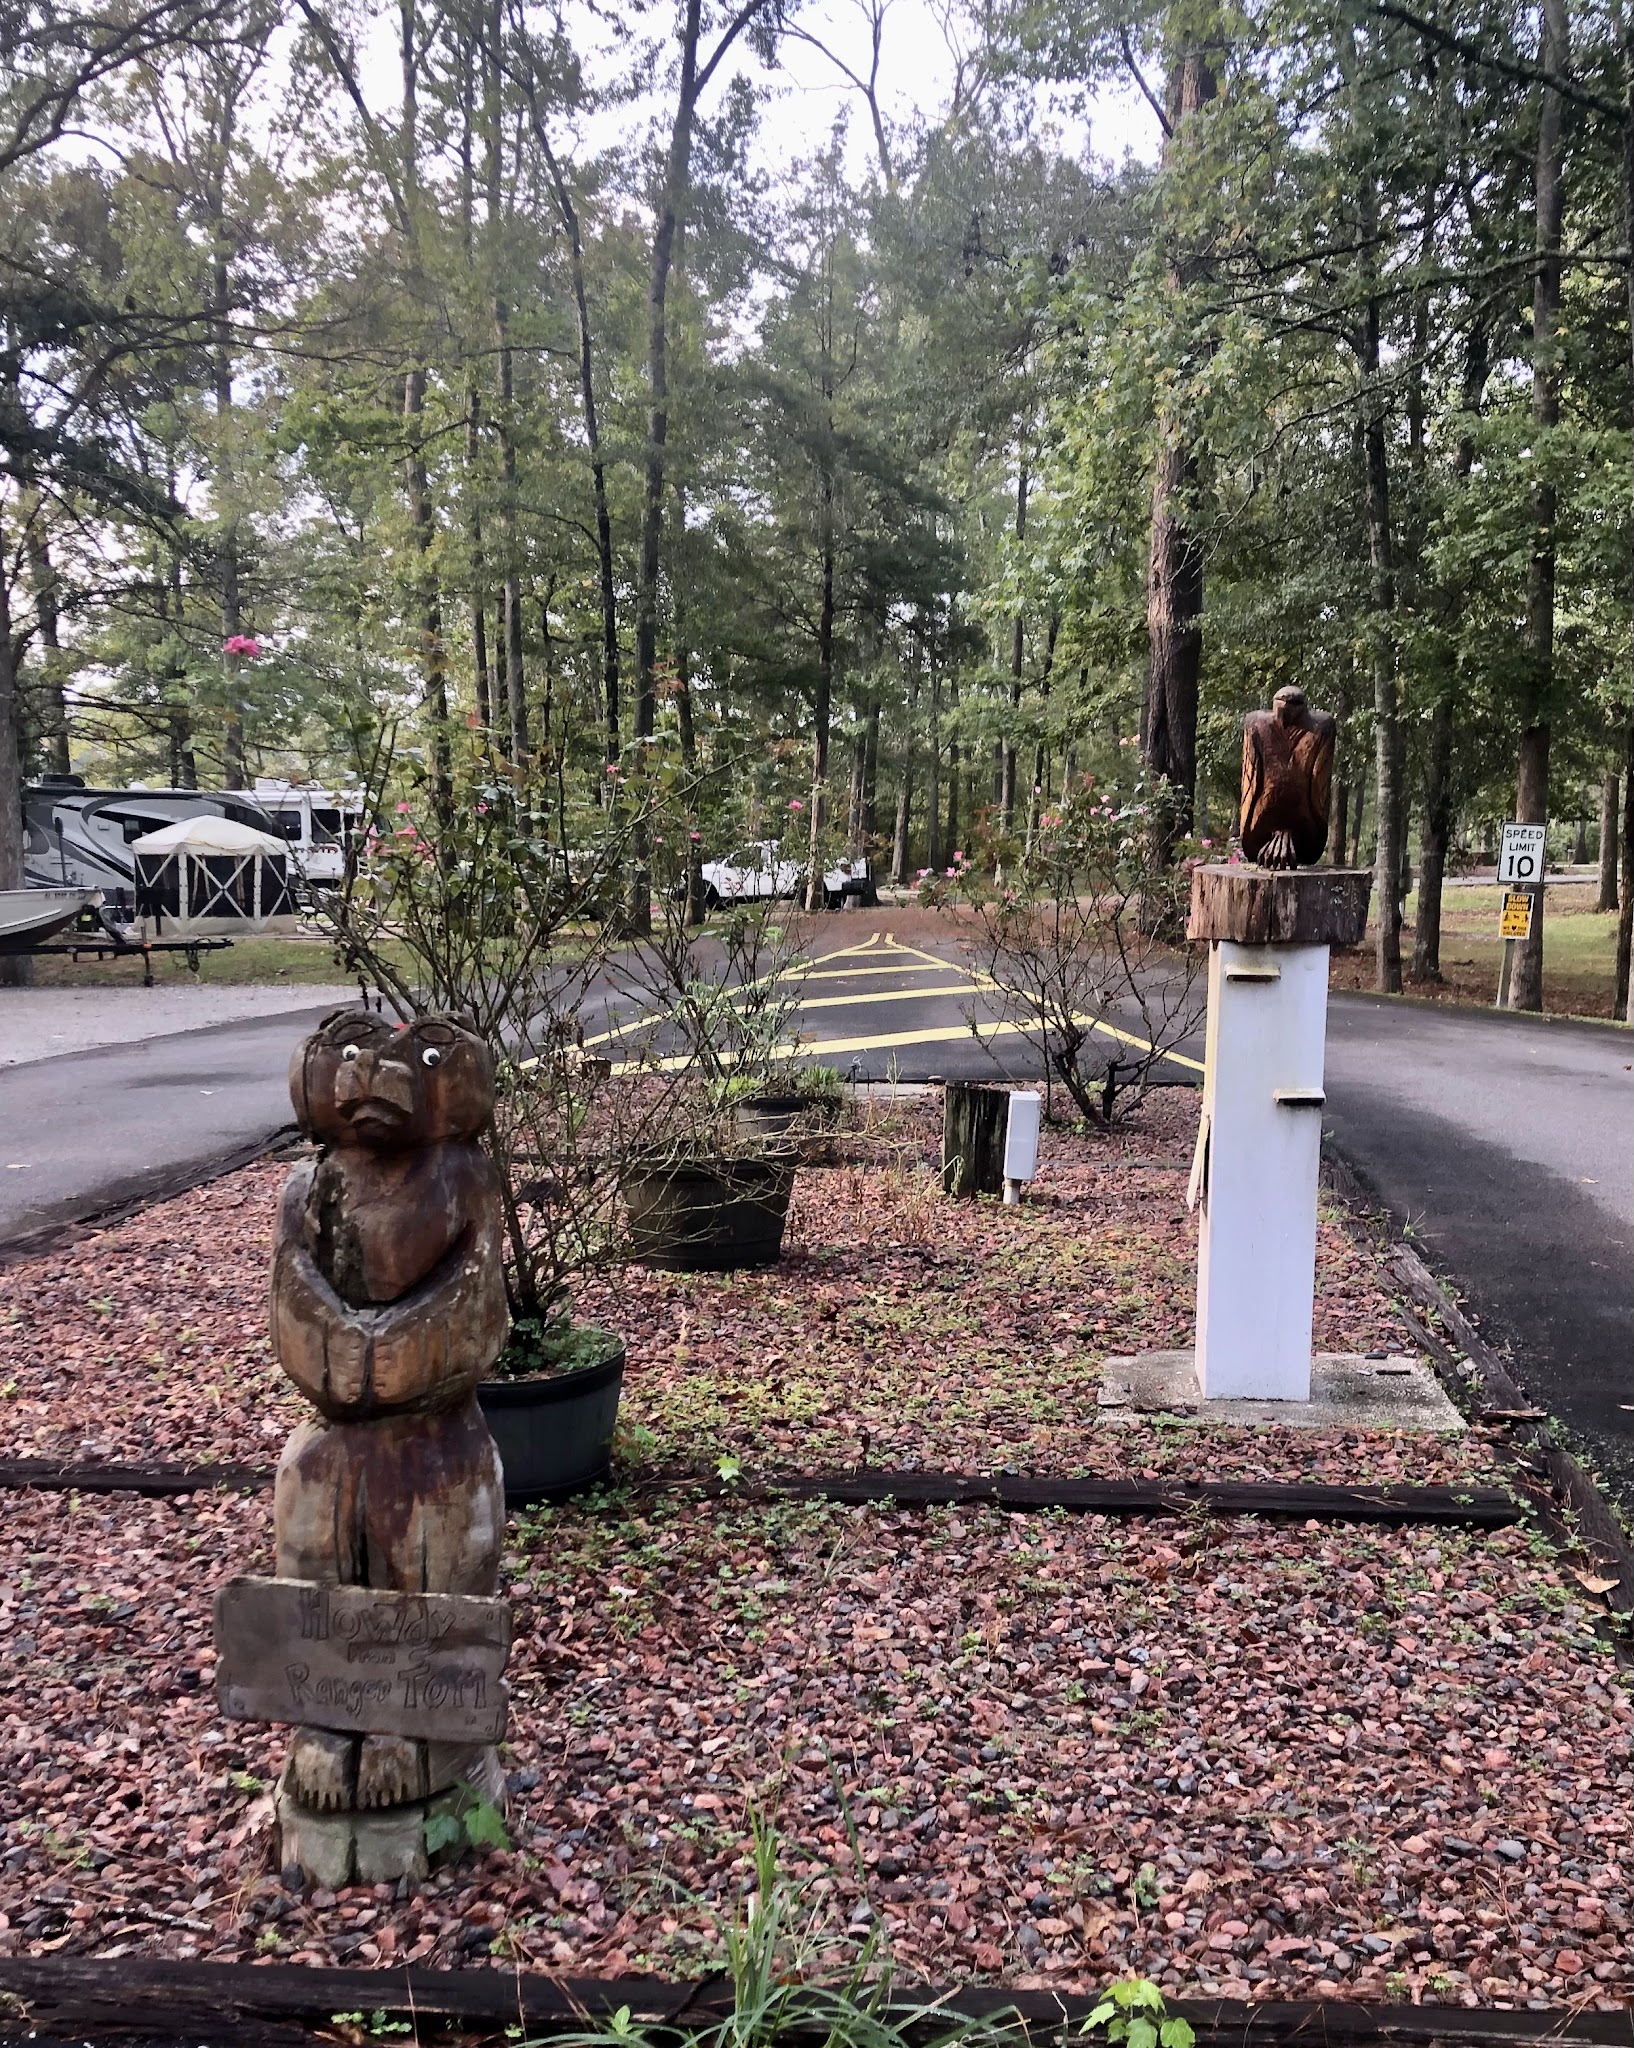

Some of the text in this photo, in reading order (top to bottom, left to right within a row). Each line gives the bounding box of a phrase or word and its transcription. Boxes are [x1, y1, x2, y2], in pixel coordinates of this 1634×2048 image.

[1505, 828, 1543, 840] SPEED
[1509, 842, 1537, 852] LIMIT
[1508, 855, 1534, 878] 10
[1508, 894, 1529, 903] SLOW
[1506, 902, 1529, 911] DOWN
[299, 1587, 457, 1660] Howdy
[284, 1662, 393, 1719] Ranger
